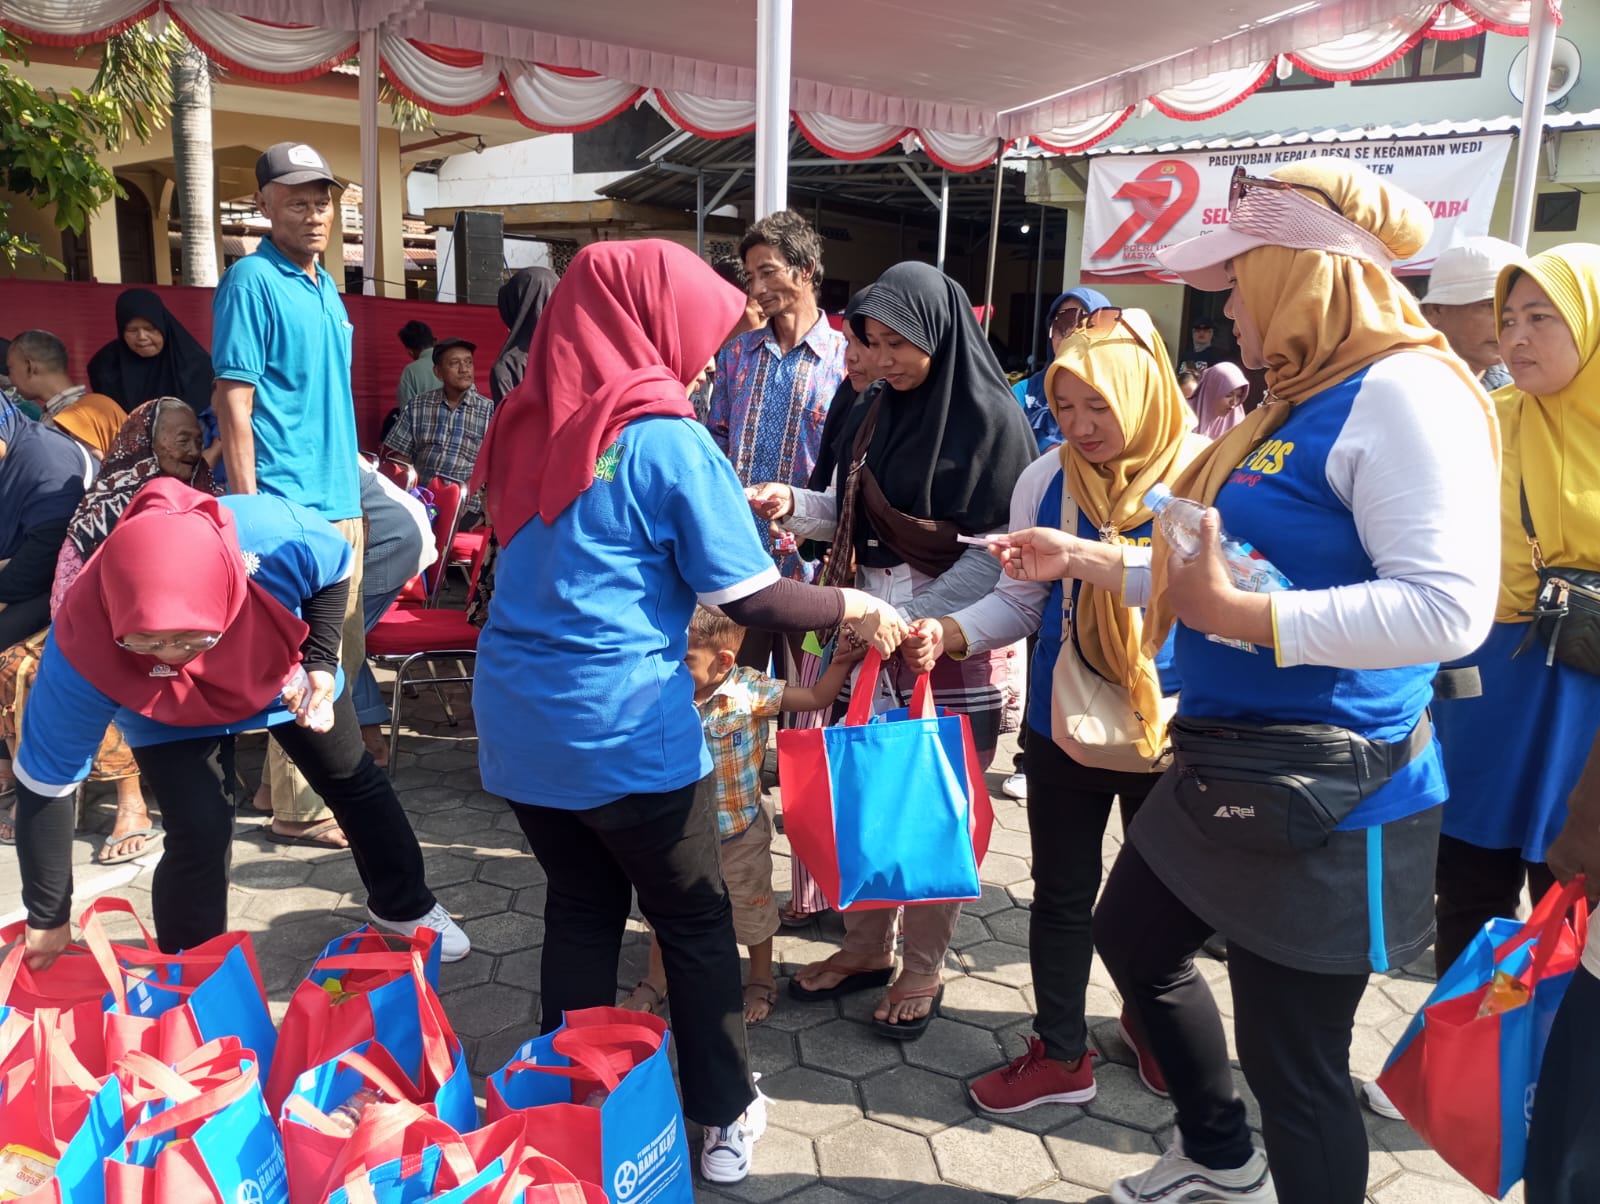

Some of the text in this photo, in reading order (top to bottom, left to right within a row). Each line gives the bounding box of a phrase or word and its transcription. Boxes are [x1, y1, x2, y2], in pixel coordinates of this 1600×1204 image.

[1209, 152, 1272, 167] PAGUYUBAN
[1275, 149, 1317, 163] KEPALA
[1354, 146, 1370, 159] SE
[1373, 143, 1445, 158] KECAMATAN
[1449, 140, 1483, 154] WEDI
